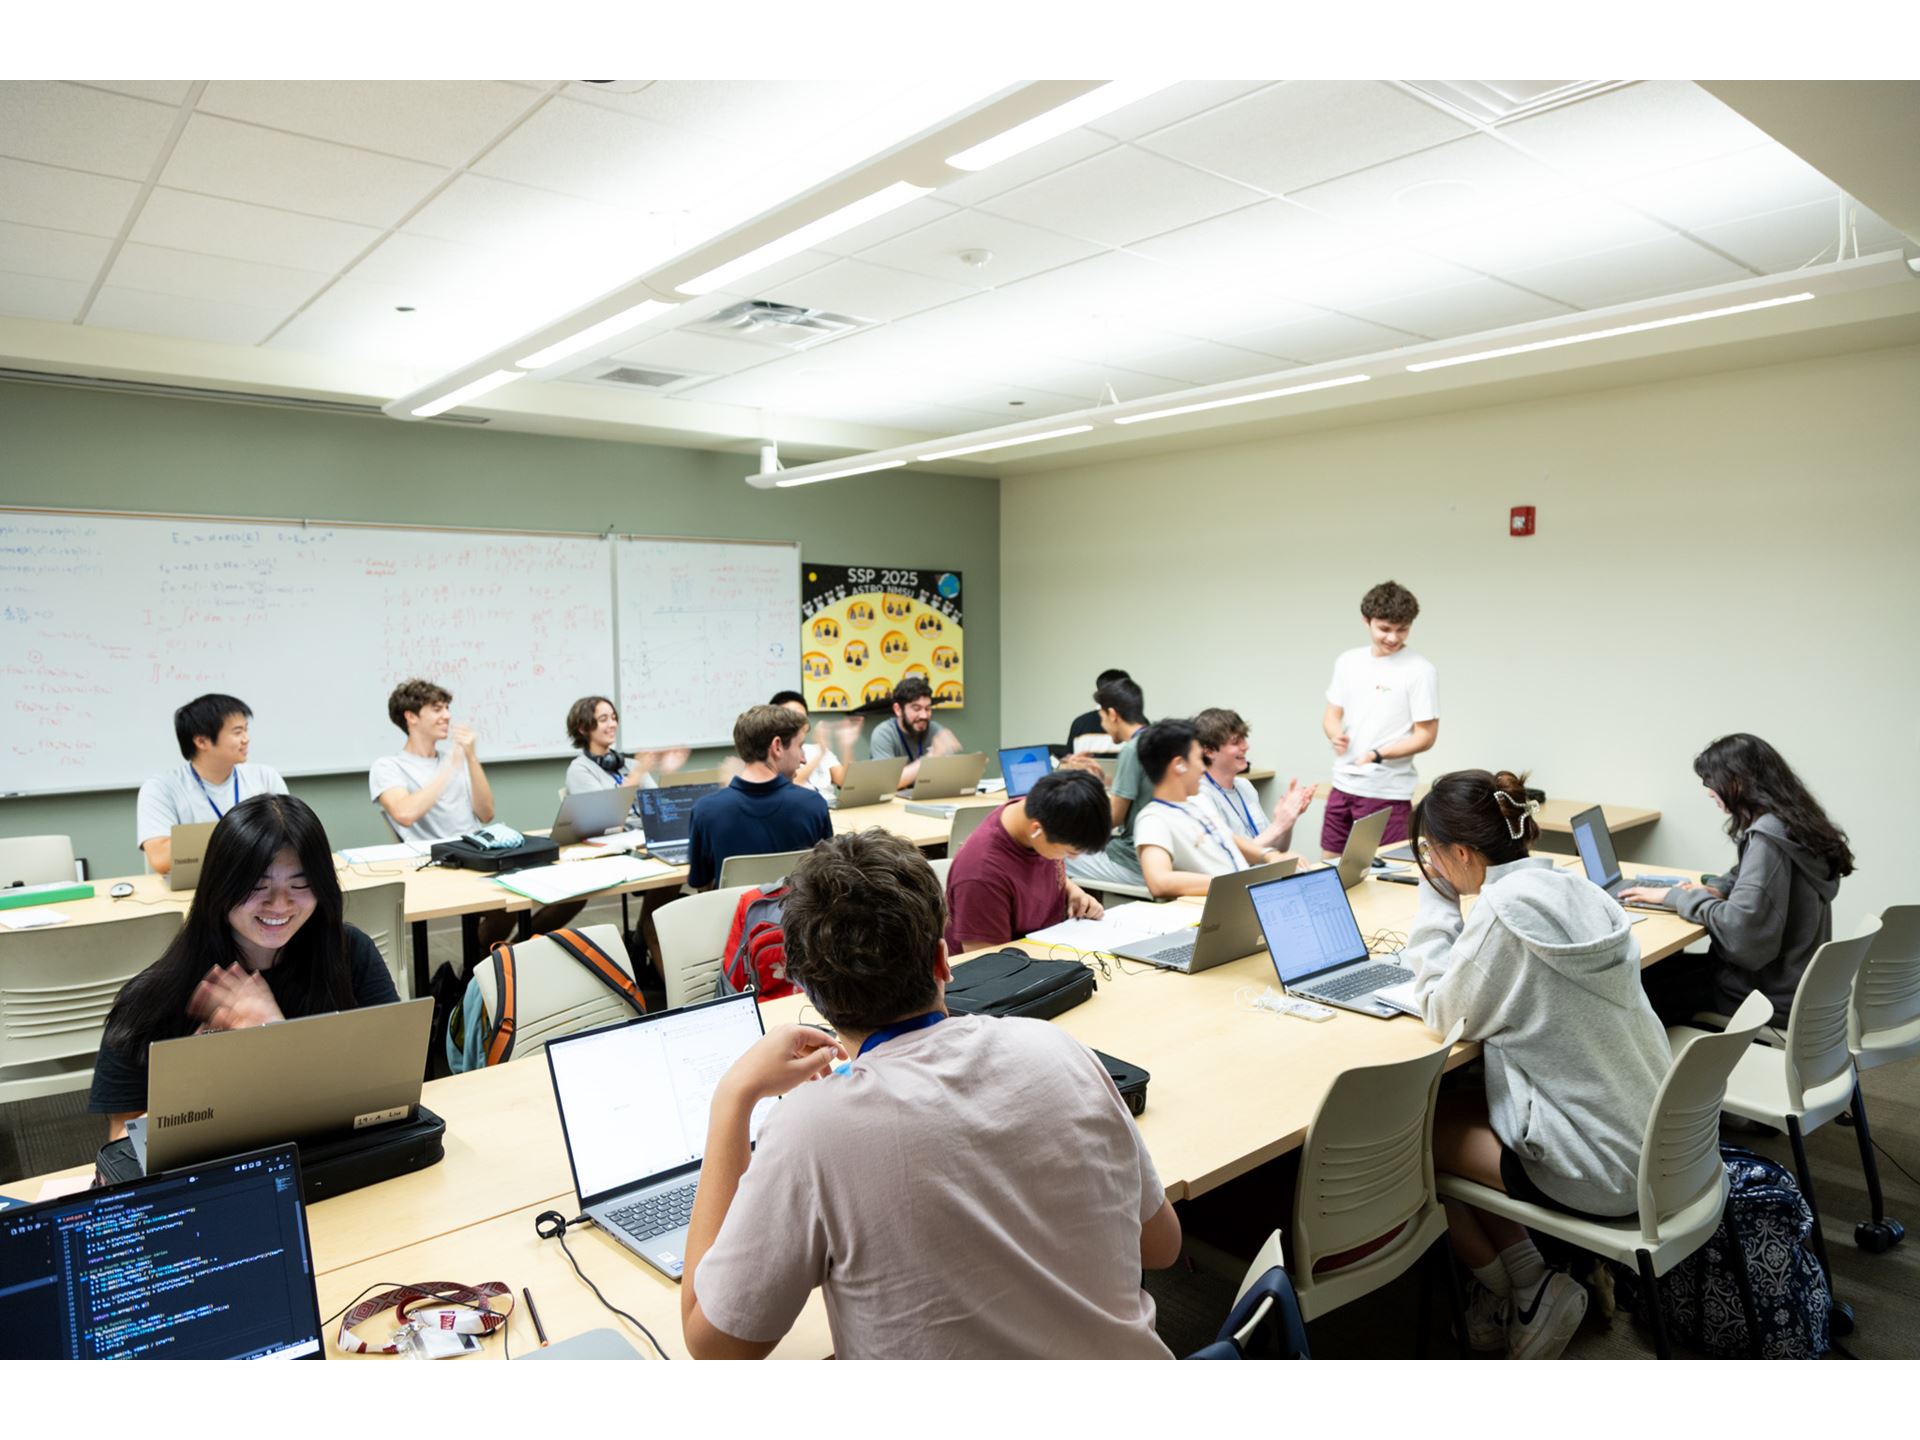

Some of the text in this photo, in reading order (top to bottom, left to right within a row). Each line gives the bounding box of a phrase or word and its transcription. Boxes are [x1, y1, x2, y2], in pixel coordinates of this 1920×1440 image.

[848, 568, 918, 586] SSP 2025
[852, 584, 915, 597] ASTRO NMSU
[157, 1107, 214, 1129] ThinkBook
